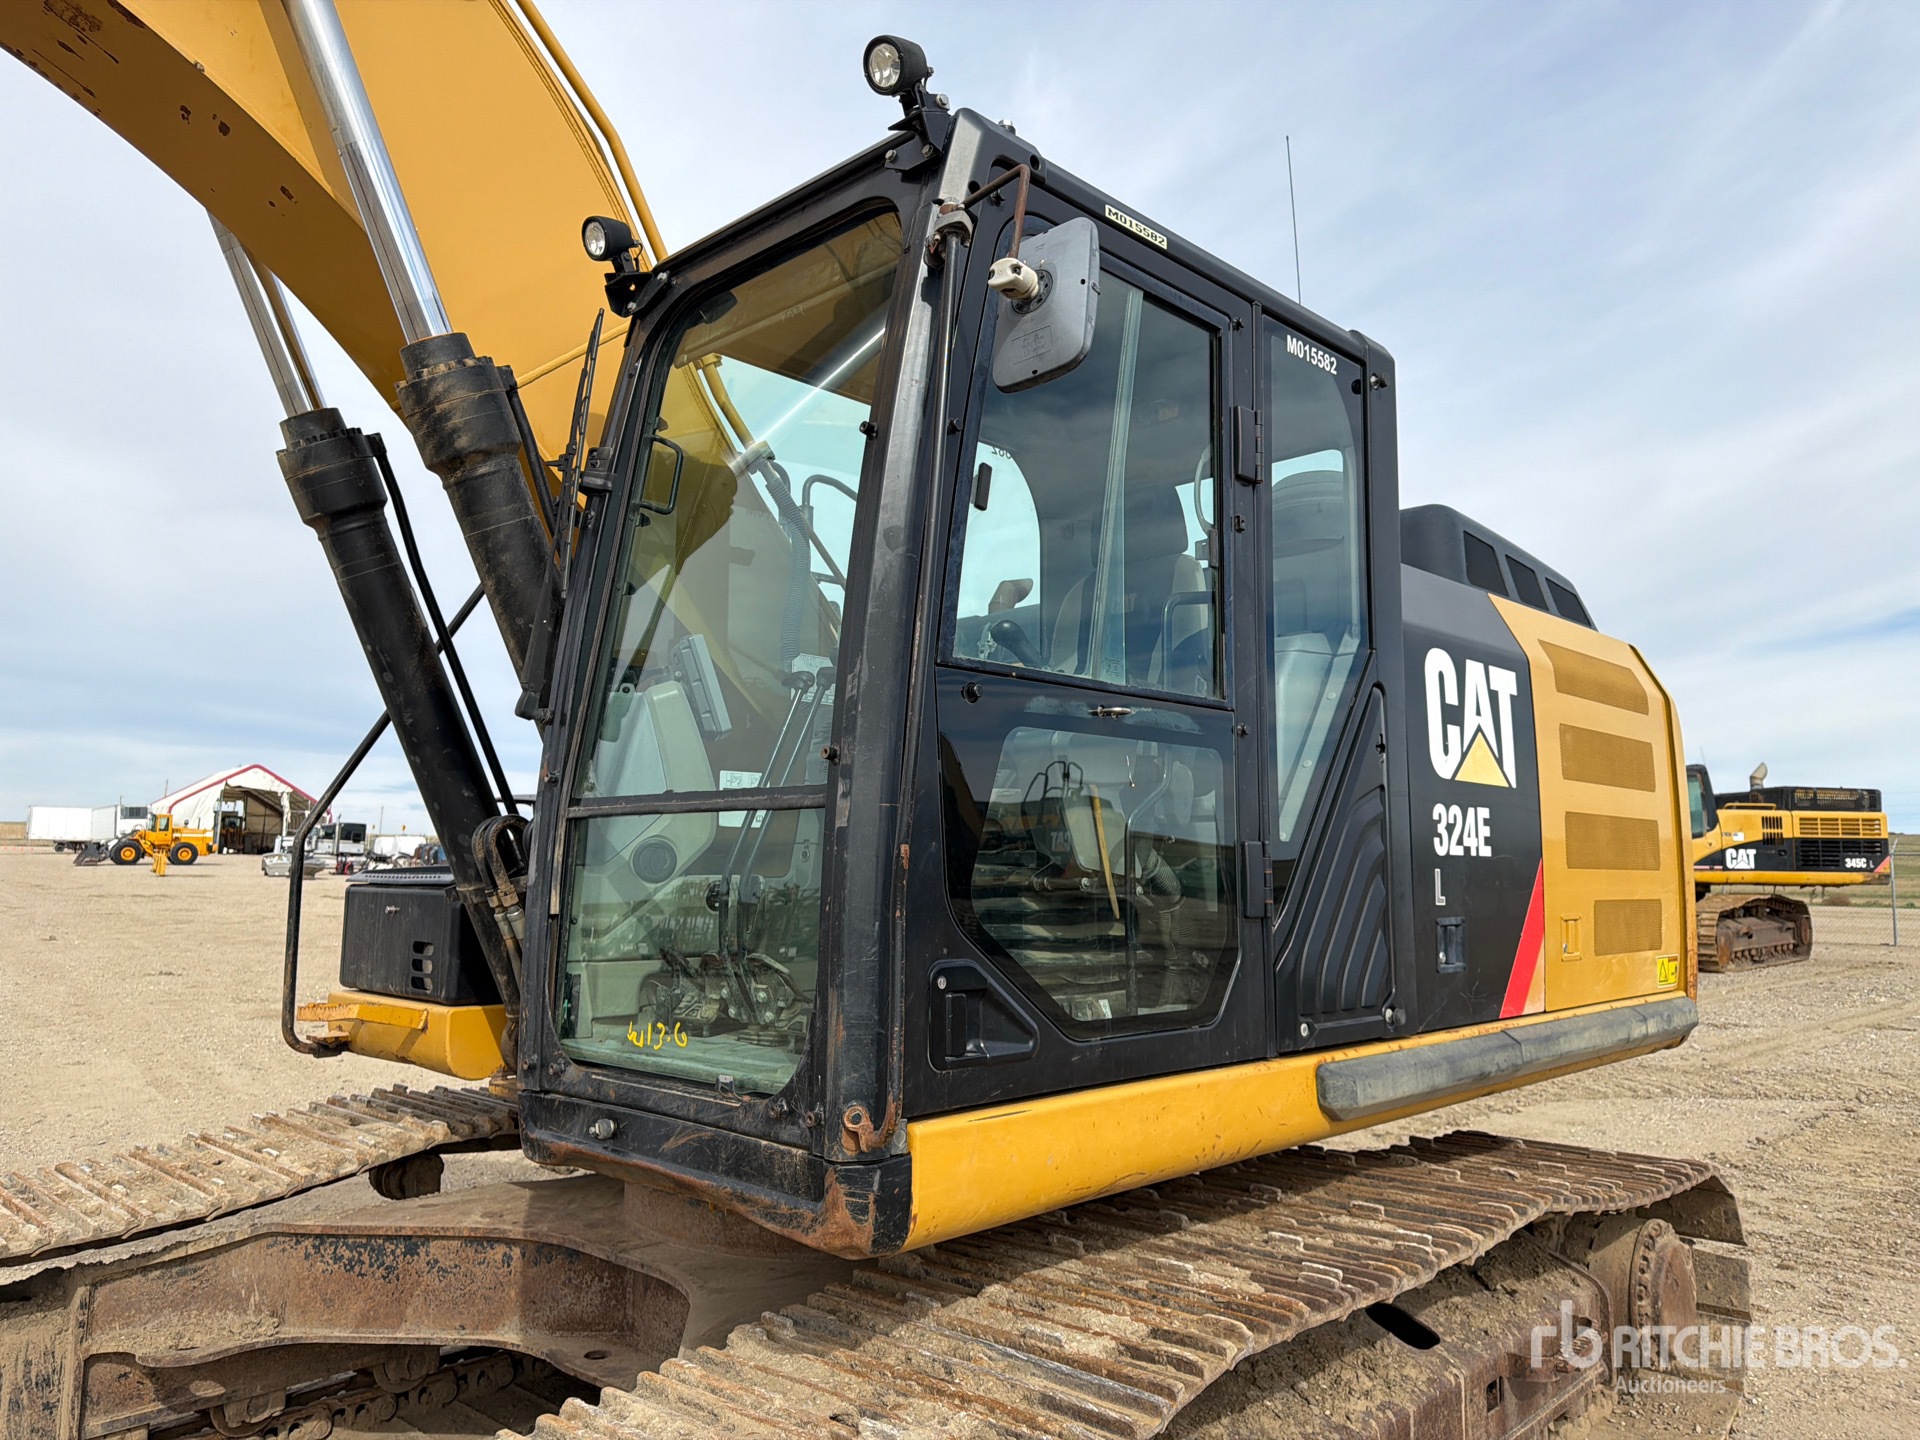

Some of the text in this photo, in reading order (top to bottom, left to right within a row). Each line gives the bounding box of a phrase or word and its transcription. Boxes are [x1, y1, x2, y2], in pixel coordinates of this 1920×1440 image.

[1107, 206, 1166, 247] M015582
[1286, 334, 1338, 375] M015582
[1424, 647, 1518, 789] CAT
[1432, 802, 1492, 858] 324E
[1725, 847, 1757, 870] CAT
[1844, 857, 1867, 869] 345C
[1434, 868, 1446, 906] L
